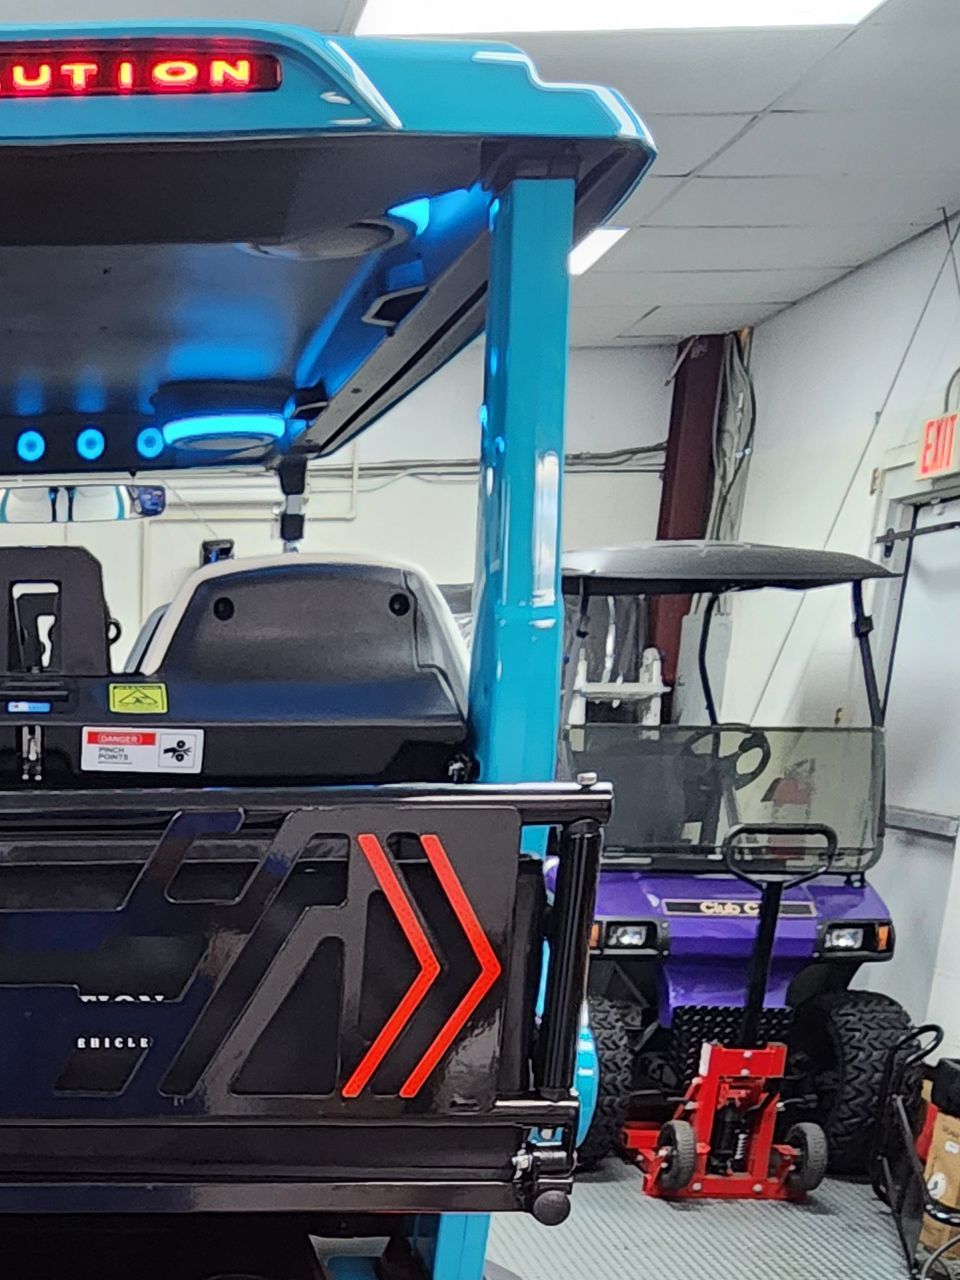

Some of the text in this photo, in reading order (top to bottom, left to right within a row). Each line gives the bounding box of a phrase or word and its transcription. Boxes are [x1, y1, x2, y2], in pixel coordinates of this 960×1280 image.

[100, 734, 138, 744] DANGER
[699, 901, 741, 916] Club
[77, 1037, 149, 1049] EHICLE
